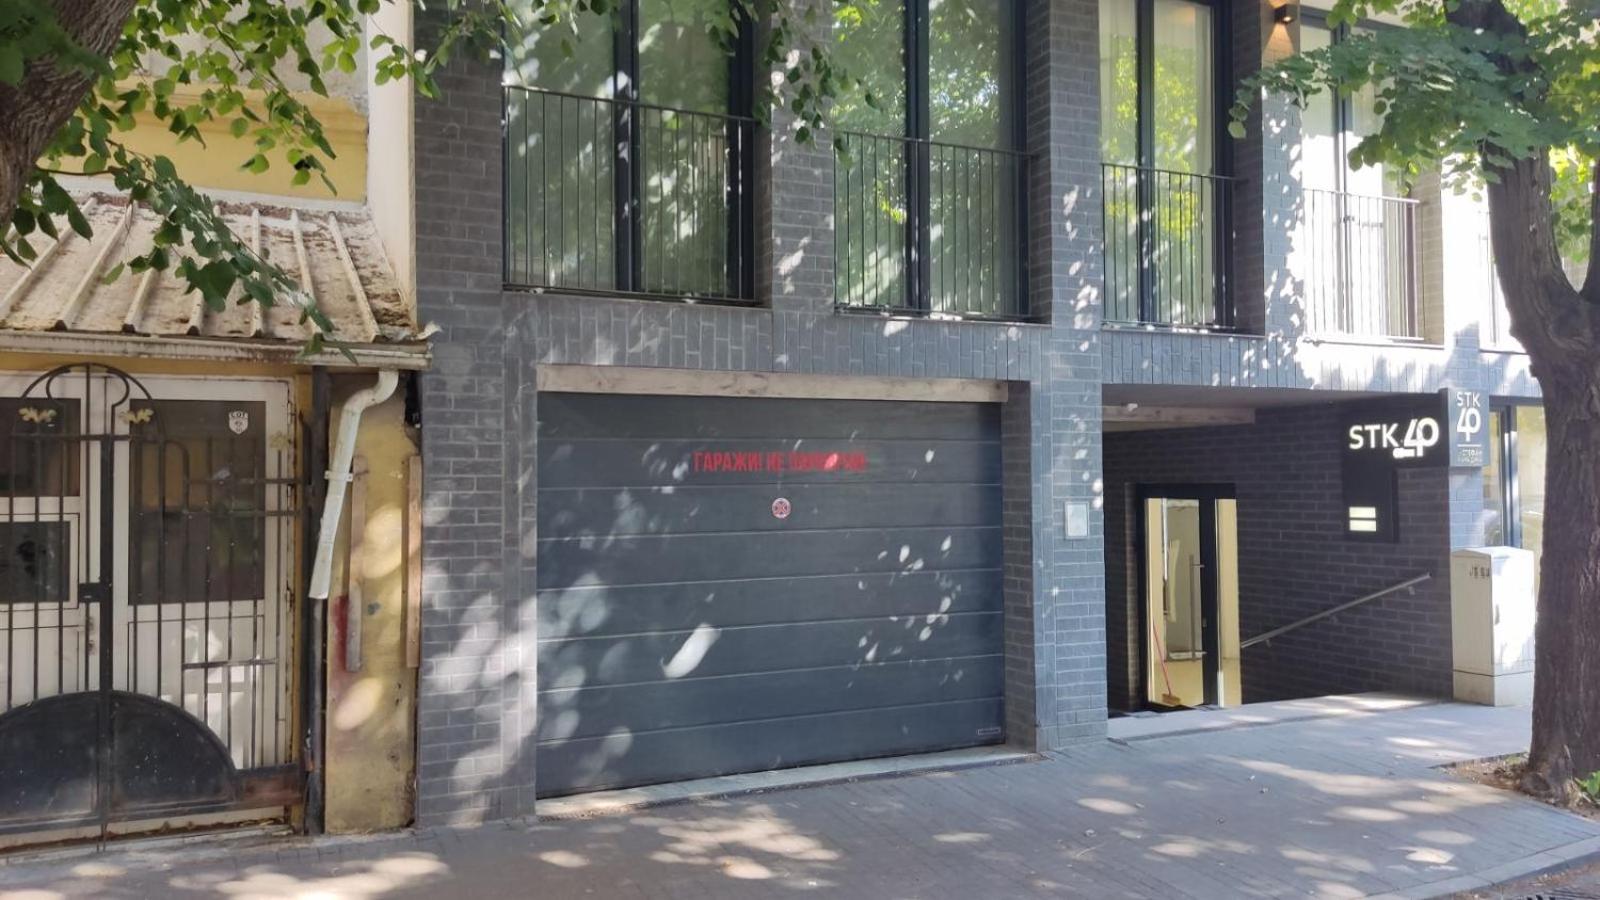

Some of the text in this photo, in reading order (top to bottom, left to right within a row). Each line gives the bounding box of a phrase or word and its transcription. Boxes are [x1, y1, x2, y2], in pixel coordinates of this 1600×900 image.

[1456, 391, 1480, 408] STK
[1349, 423, 1399, 449] STK
[1403, 417, 1439, 457] 40
[1456, 408, 1481, 442] 40
